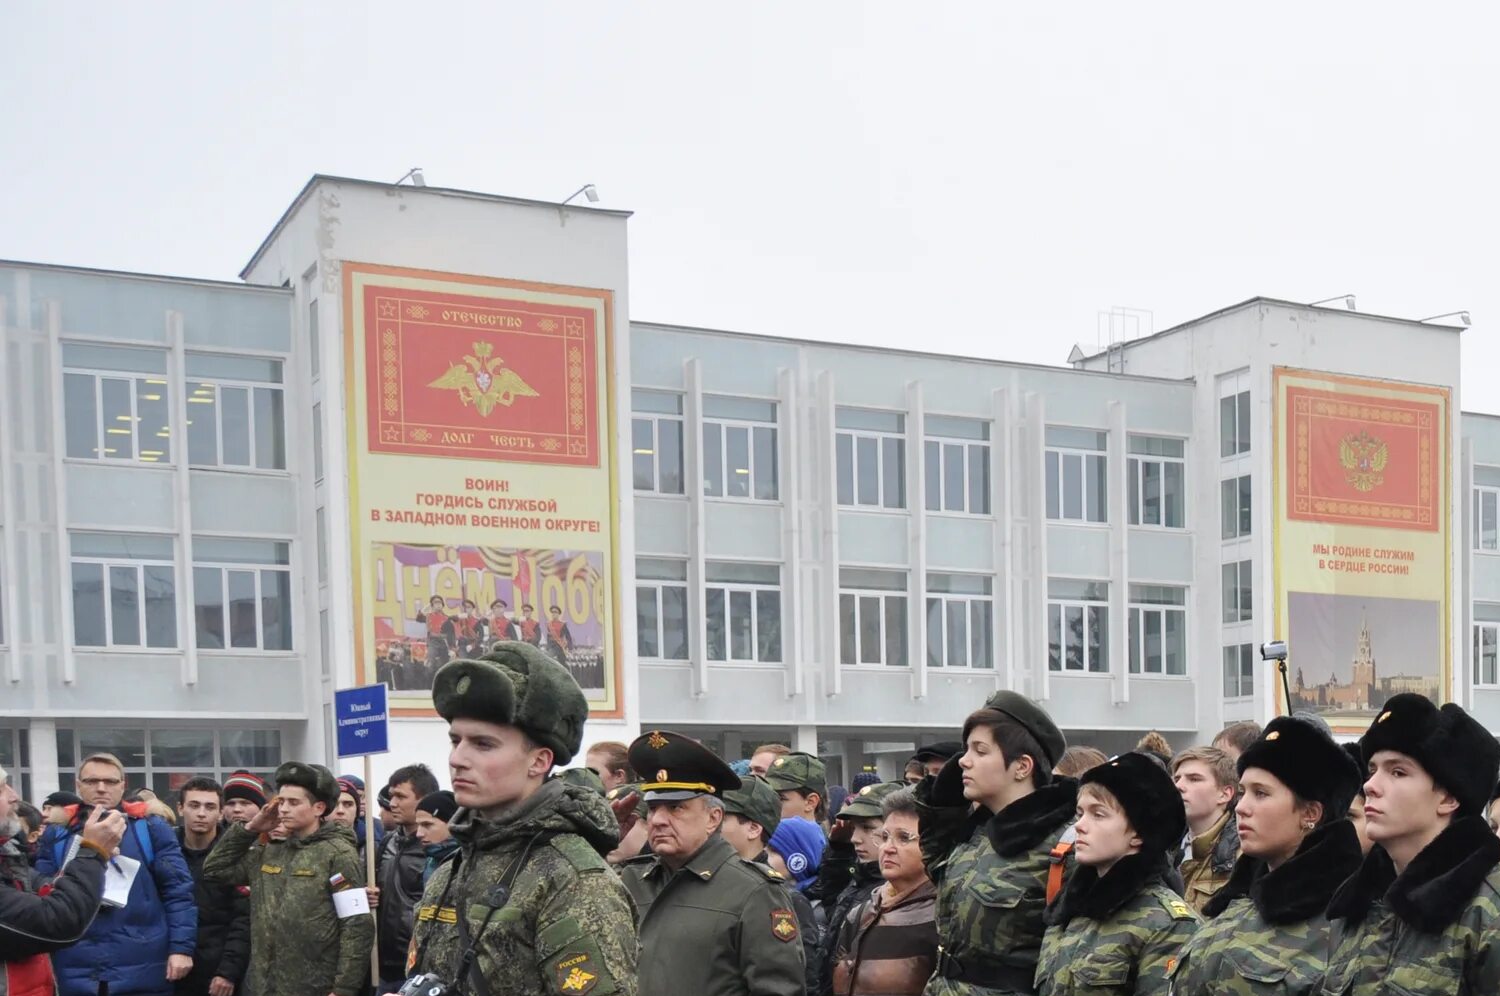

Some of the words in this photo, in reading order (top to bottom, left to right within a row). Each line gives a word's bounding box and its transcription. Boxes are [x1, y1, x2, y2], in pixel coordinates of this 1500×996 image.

[441, 309, 523, 329] ОТЕЧЕСТВО
[440, 431, 475, 447] ДОЛГ
[490, 433, 536, 449] ЧЕСТЬ
[465, 478, 510, 493] ВОИН!
[416, 493, 484, 509] ГОРДИСЬ
[488, 496, 557, 513] СЛУЖБОЙ
[371, 509, 381, 521] В
[385, 510, 467, 527] ЗАПАДНОМ
[472, 515, 541, 530] ВОЕННОМ
[545, 518, 601, 533] ОКРУГЕ!
[1313, 544, 1330, 555] МЫ
[1332, 546, 1371, 560] РОДИНЕ
[1373, 549, 1415, 562] СЛУЖИМ
[1319, 559, 1326, 569] В
[1328, 560, 1366, 574] СЕРДЦЕ
[1369, 562, 1409, 575] РОССИИ!
[559, 955, 587, 969] РОССИЯ
